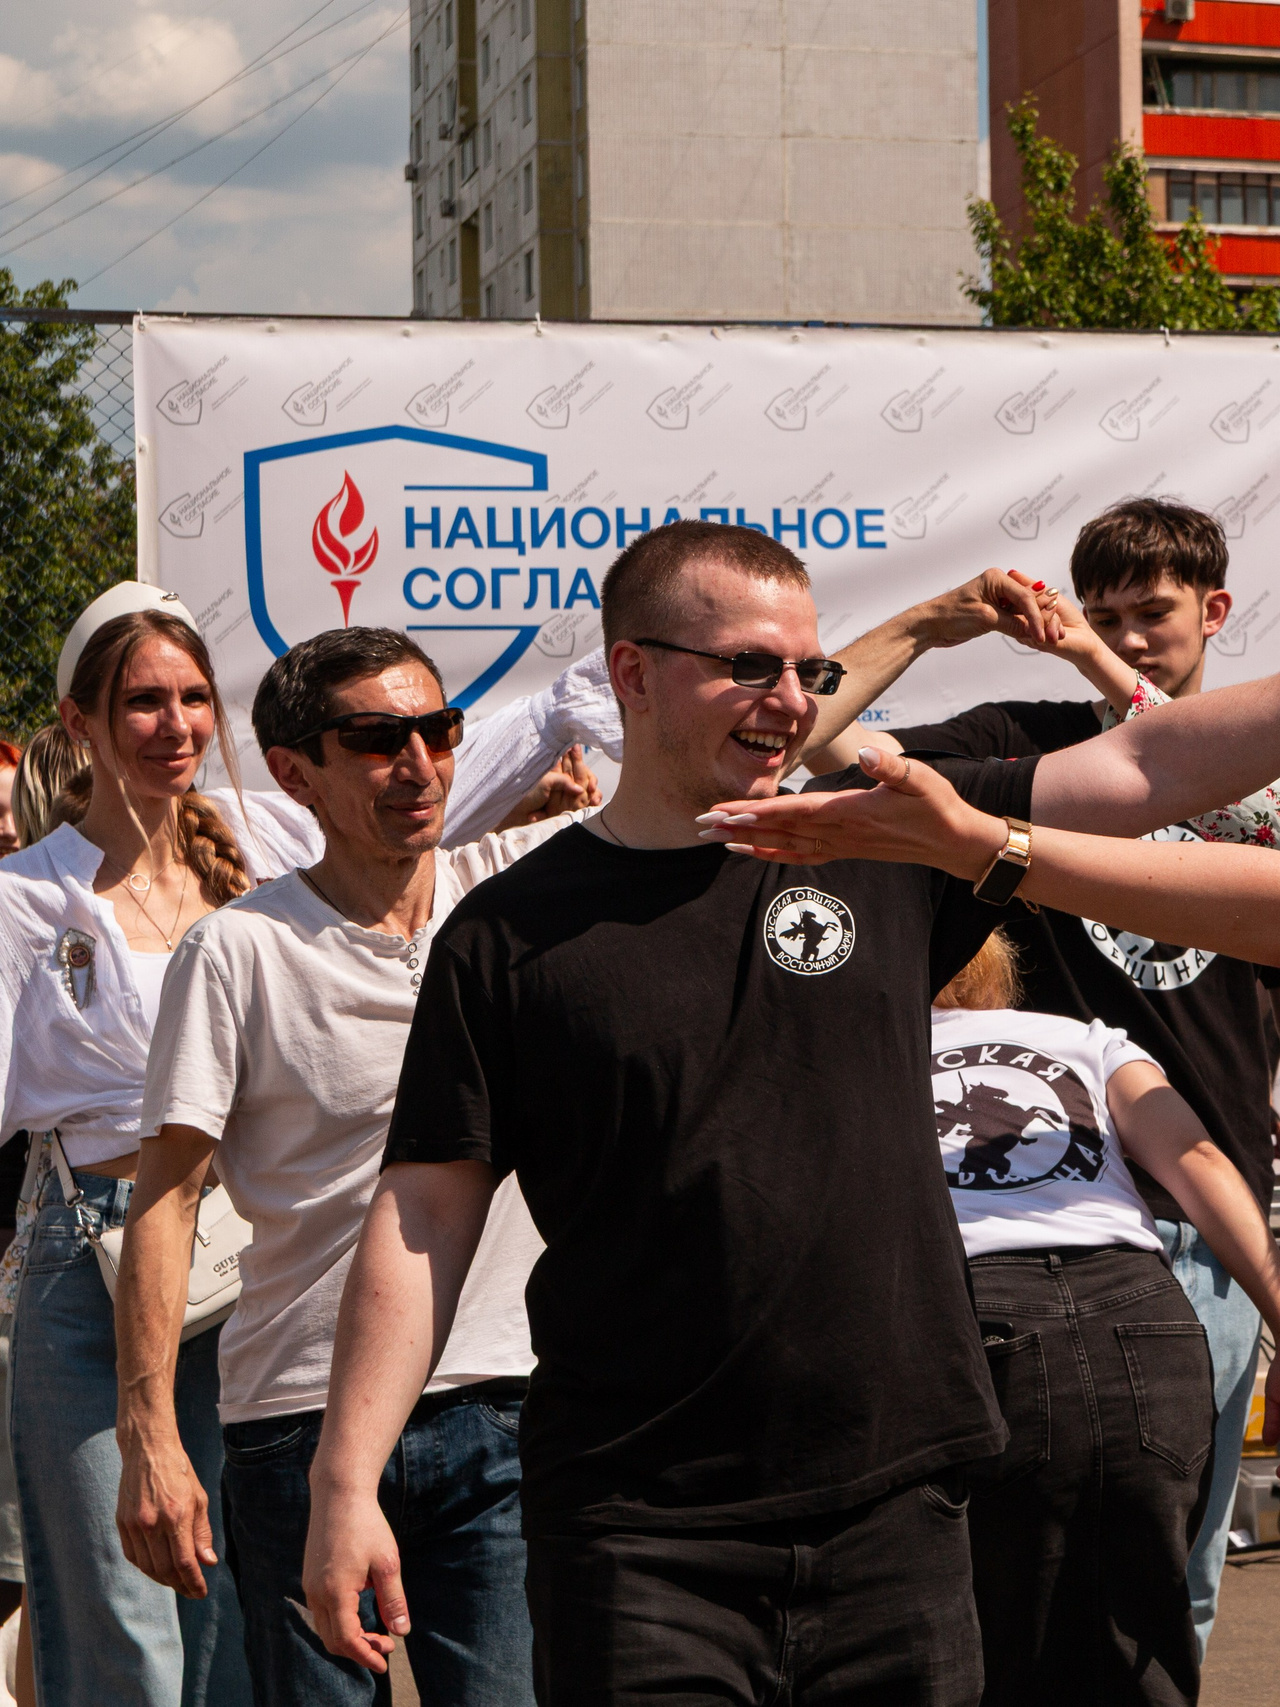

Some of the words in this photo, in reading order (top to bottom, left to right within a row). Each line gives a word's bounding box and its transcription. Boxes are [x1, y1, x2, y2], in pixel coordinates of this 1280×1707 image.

[402, 567, 602, 611] СОГЛА
[767, 894, 792, 939] РУССКАЯ
[795, 890, 847, 918] ОБЩИНА
[775, 951, 839, 972] ВОСТОЧНЫЙ
[837, 929, 854, 956] ОКРУГ
[937, 1045, 1068, 1083] СКАЯ
